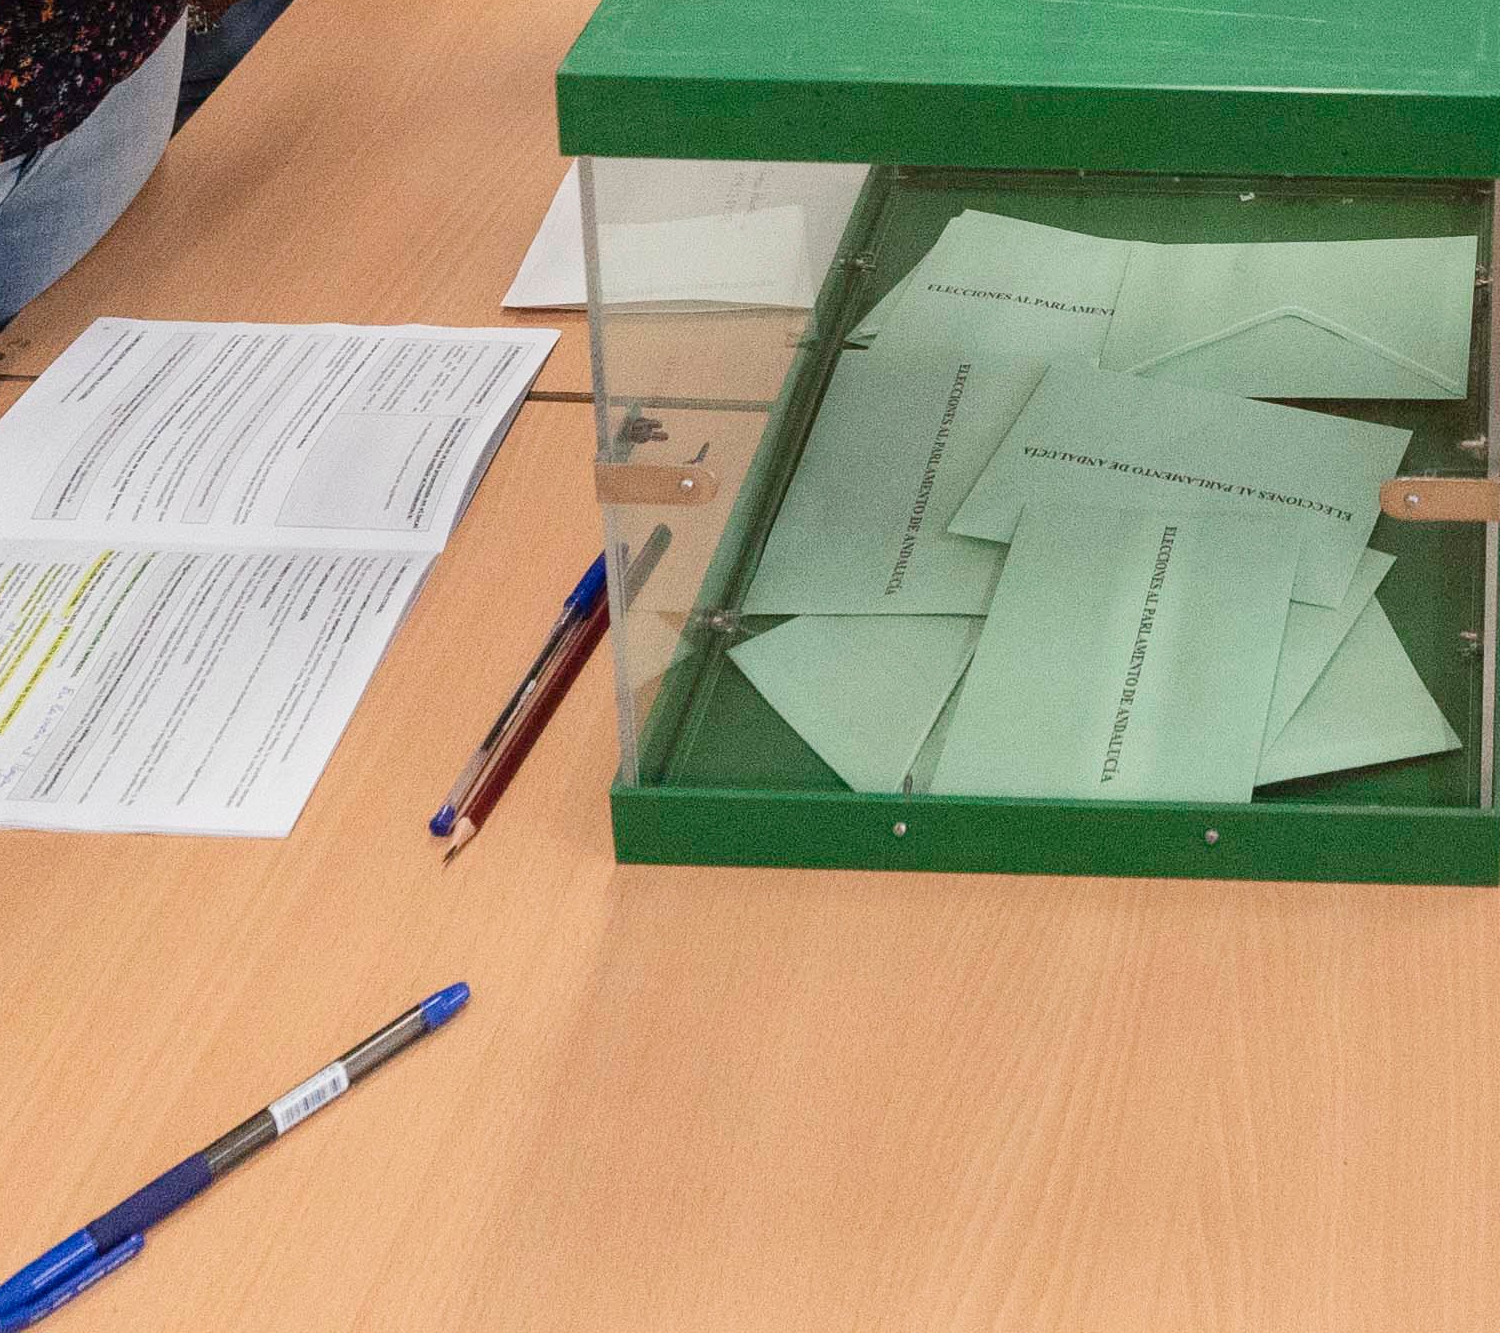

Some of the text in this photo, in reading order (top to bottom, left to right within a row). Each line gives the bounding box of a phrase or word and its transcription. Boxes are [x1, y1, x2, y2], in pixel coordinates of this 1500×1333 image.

[926, 284, 1116, 317] ELECCIONES AL PARLAMENT
[885, 363, 971, 596] ELECCIONES AL PARLAMENTO DE ANDALUCÍA
[1022, 444, 1353, 522] ELECCIONES AL PARLAMENTO DE ANDALUCÍA
[1100, 525, 1177, 784] ELECCIONES AL PARLAMENTO DE ANDALUCÍA
